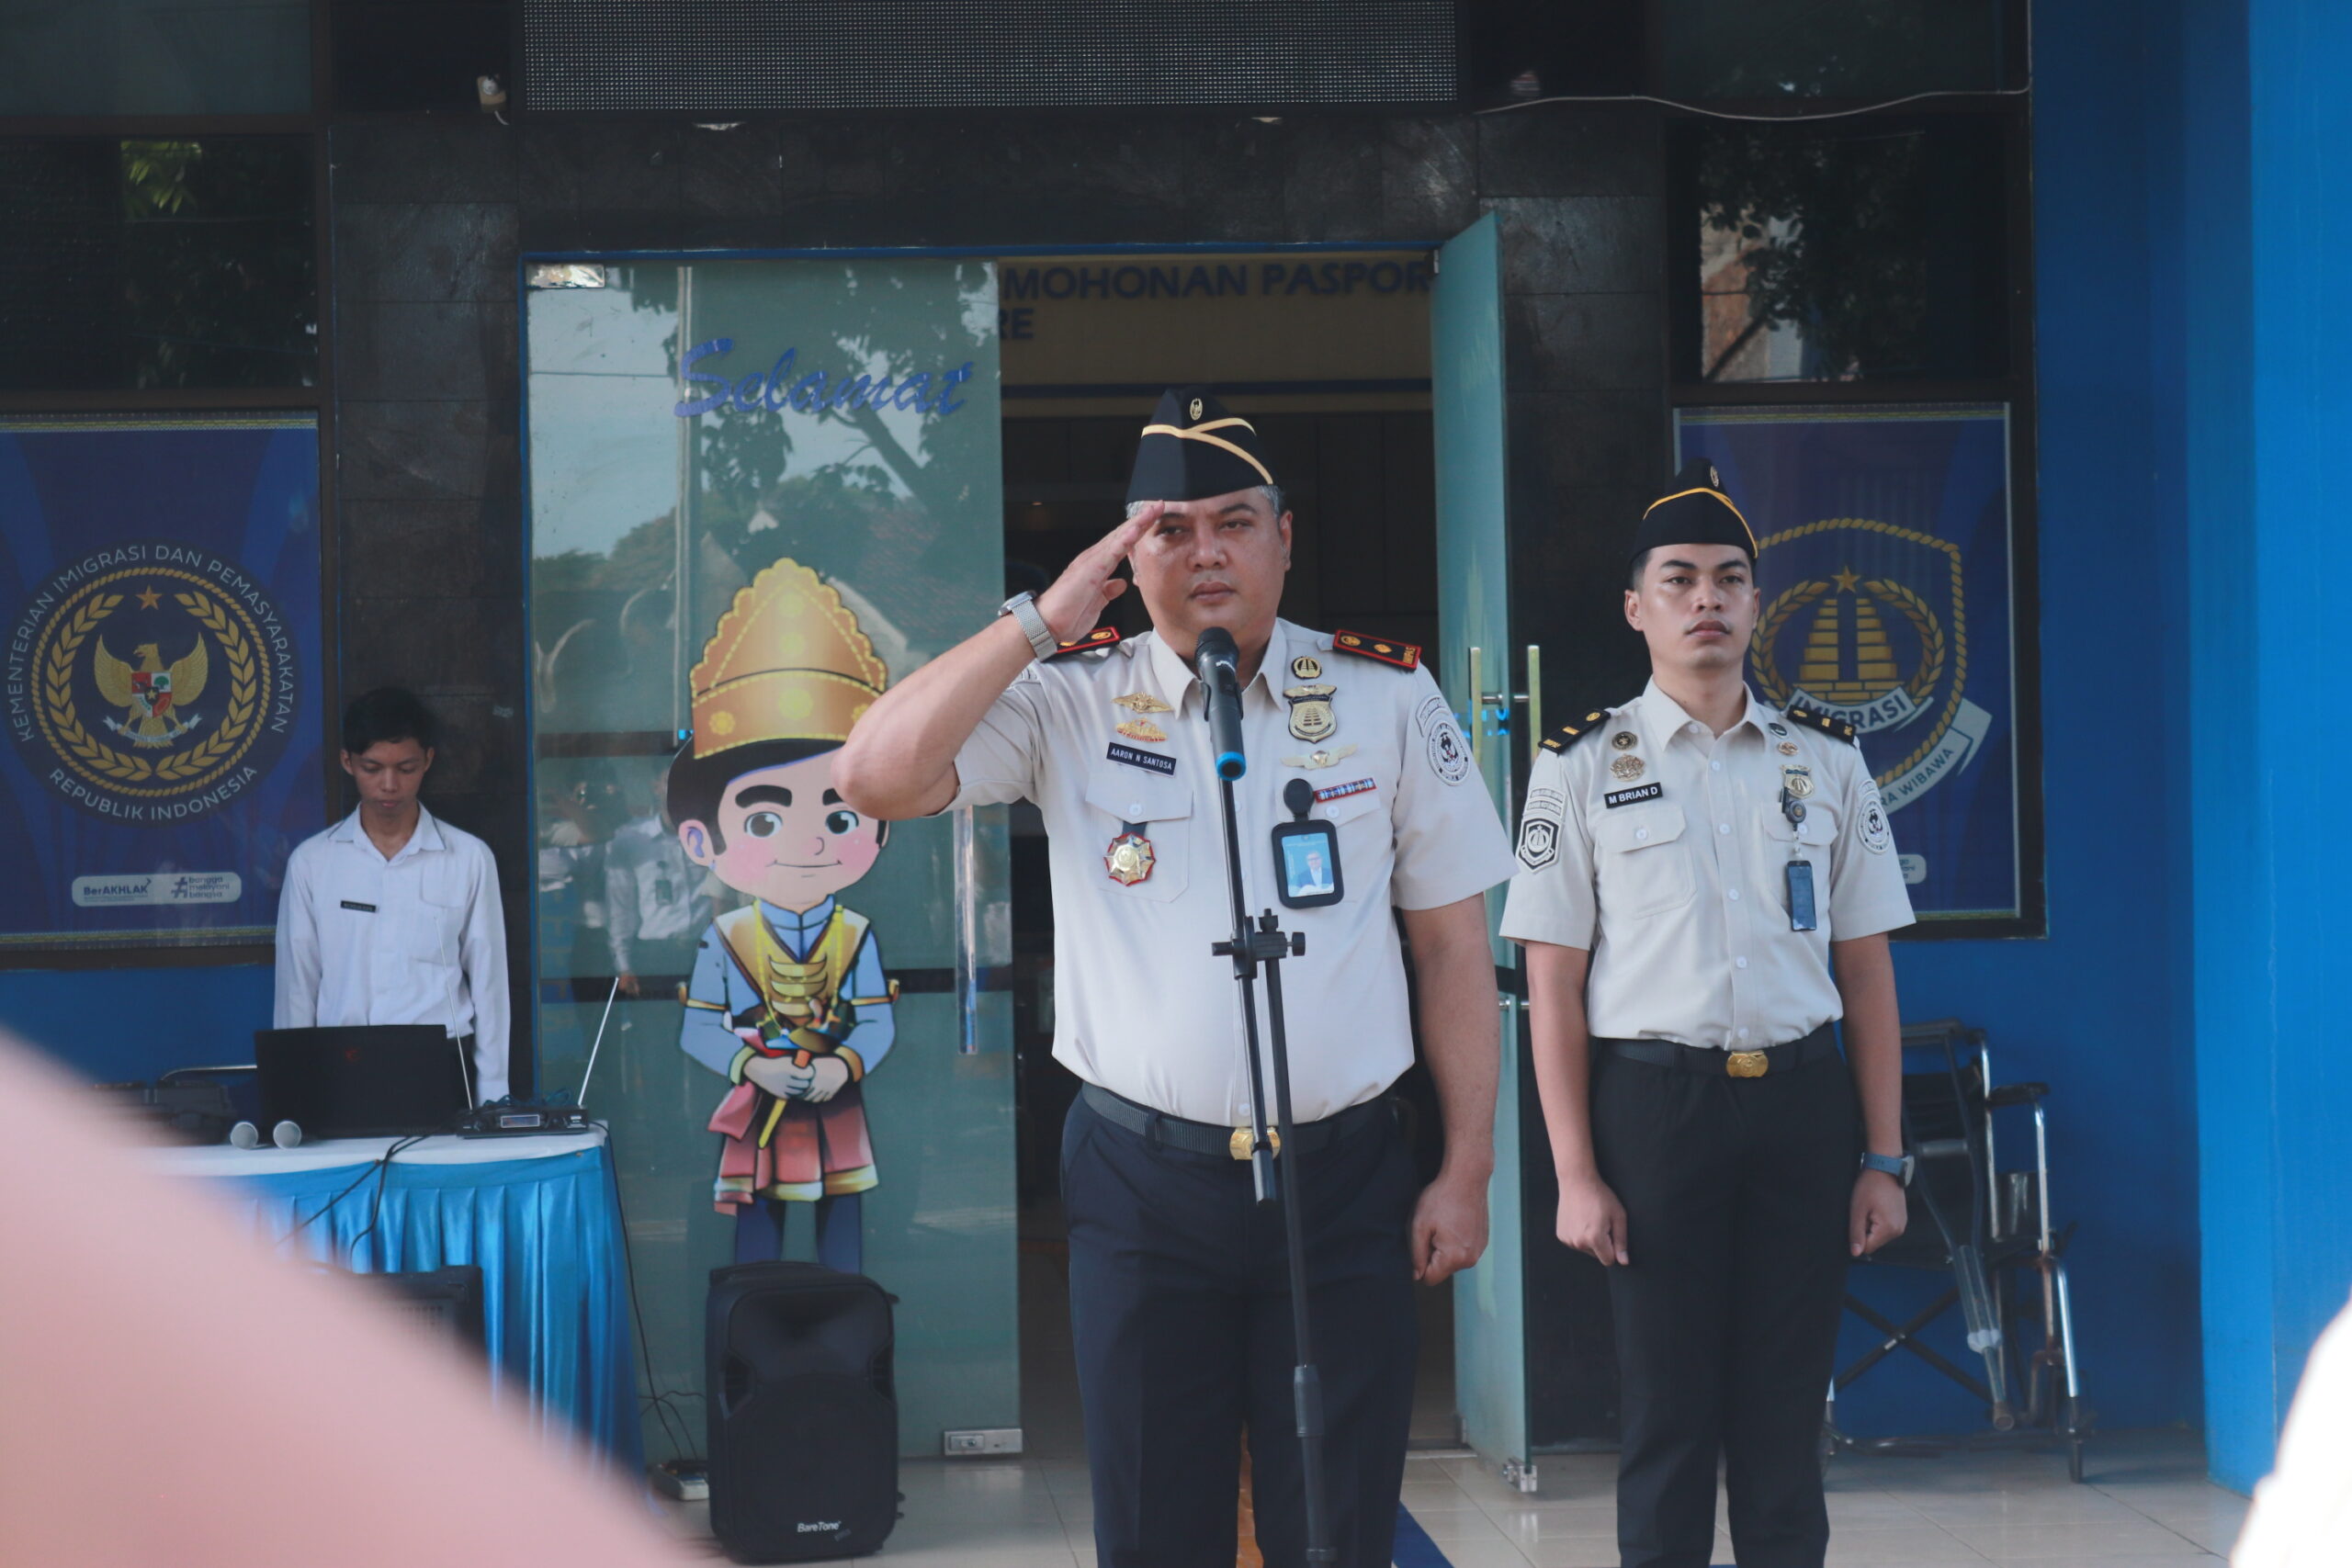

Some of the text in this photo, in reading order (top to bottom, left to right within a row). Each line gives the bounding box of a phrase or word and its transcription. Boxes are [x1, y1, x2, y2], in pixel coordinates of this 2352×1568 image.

[1261, 262, 1430, 295] PASPOR
[674, 338, 974, 417] Selamat
[8, 545, 293, 742] KEMENTERIAN IMIGRASI DAN PEMASYARAKATAN
[1111, 748, 1172, 770] AARON N SANTOSA
[1898, 748, 1954, 796] WIBAWA
[50, 766, 257, 819] REPUBLIK INDONESIA
[1609, 786, 1657, 804] M BRIAN D
[84, 884, 149, 897] BerAKHLAK
[797, 1520, 840, 1532] BareTone
